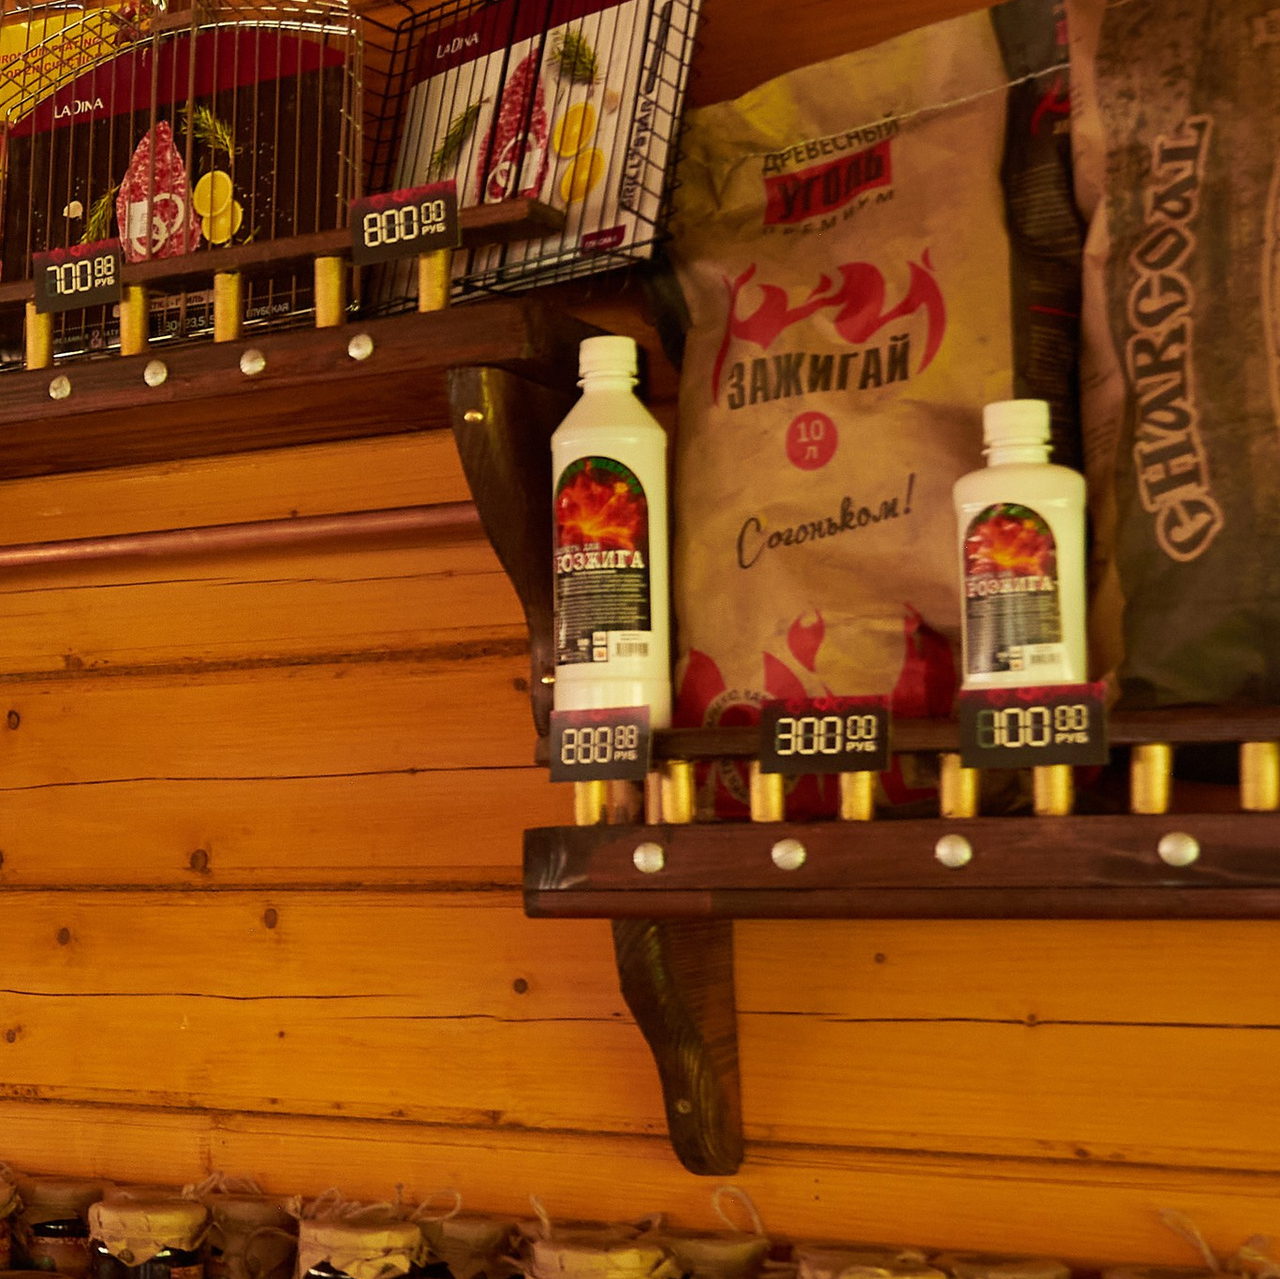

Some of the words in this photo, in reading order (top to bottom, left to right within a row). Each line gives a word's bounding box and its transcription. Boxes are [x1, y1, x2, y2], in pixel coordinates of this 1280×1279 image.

[762, 112, 899, 176] ДРЕВЕСНЫЙ
[776, 150, 885, 221] УГОЛЬ
[363, 206, 419, 248] 800
[421, 223, 446, 237] РУБ
[46, 260, 92, 295] 700
[94, 276, 115, 288] РУБ
[1126, 115, 1223, 561] CHARCOAL
[727, 333, 911, 411] ЗАЖИГАЙ
[796, 420, 825, 443] 10
[557, 549, 645, 574] РОЗЖИГА
[777, 716, 843, 756] 300
[993, 706, 1051, 748] 100
[1055, 732, 1089, 745] РУБ
[846, 741, 878, 753] РУБ
